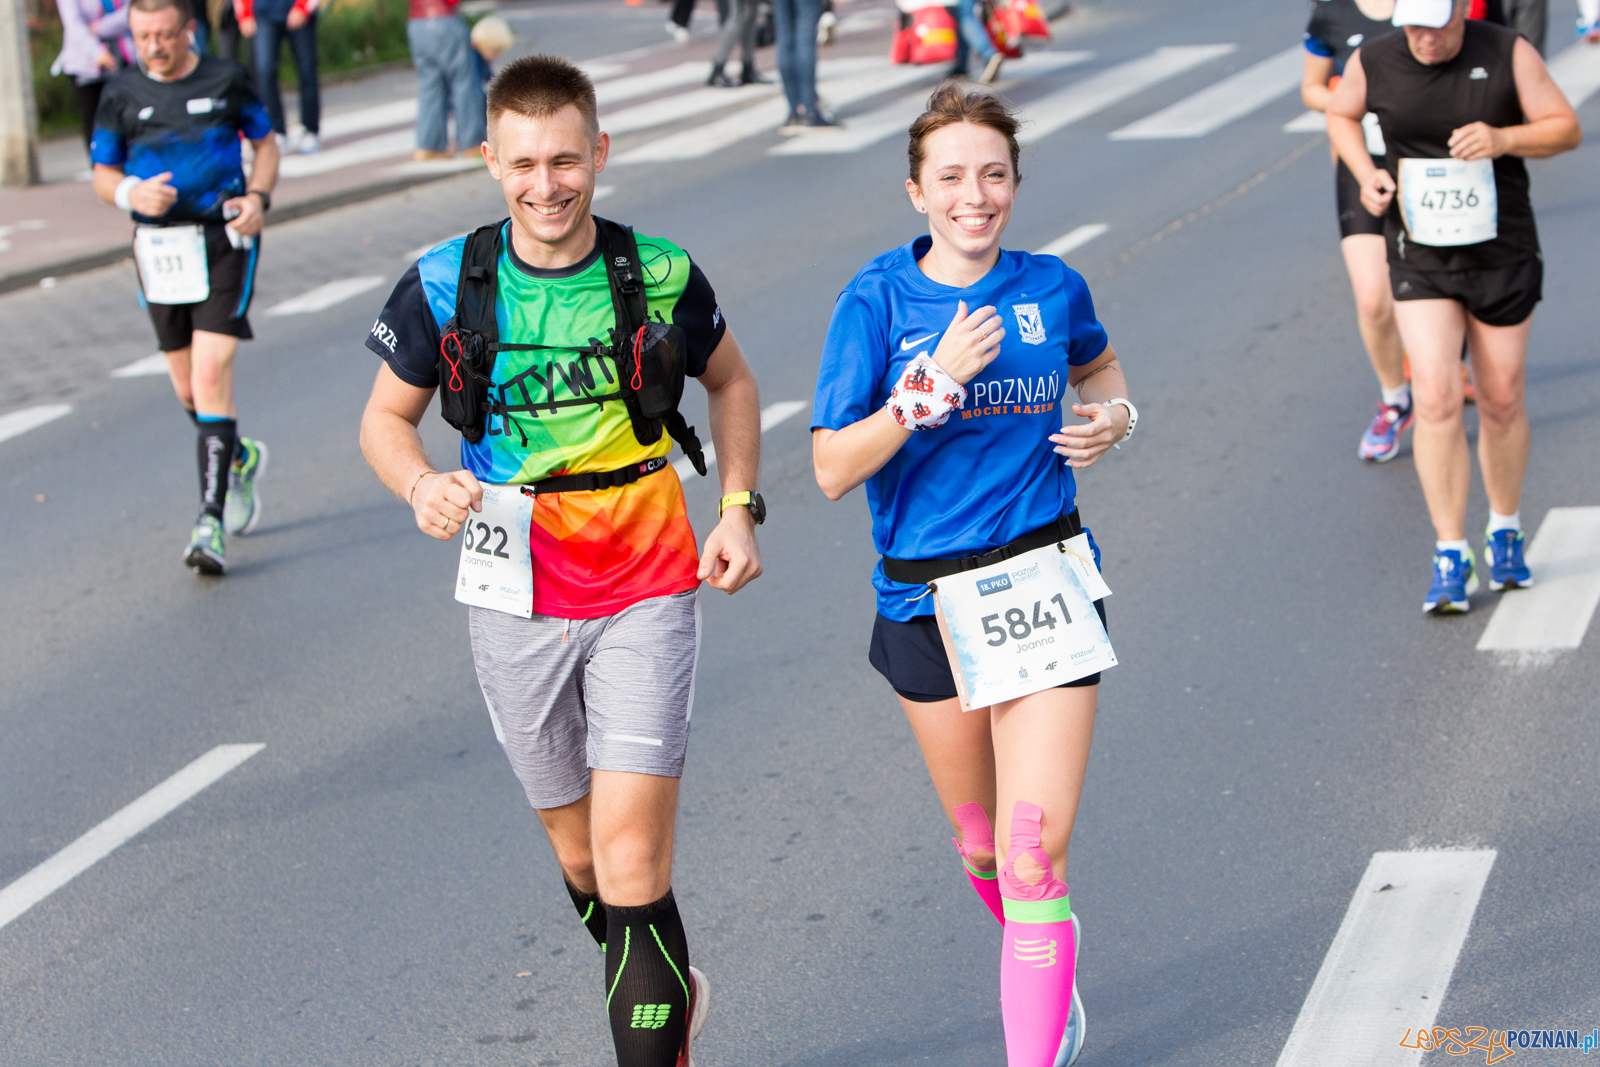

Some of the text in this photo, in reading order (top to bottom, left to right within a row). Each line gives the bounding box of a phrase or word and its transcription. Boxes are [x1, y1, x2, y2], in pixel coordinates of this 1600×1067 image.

[1421, 187, 1479, 210] 4736
[153, 254, 182, 273] 831
[974, 370, 1059, 407] POZNAŃ
[961, 402, 1055, 420] MOCNI RAZEM
[464, 518, 510, 560] 622
[464, 554, 493, 568] Joanna
[980, 578, 1008, 592] 18. PKO
[981, 592, 1073, 647] 5841
[1016, 636, 1055, 654] Joanna
[630, 1020, 666, 1029] cep
